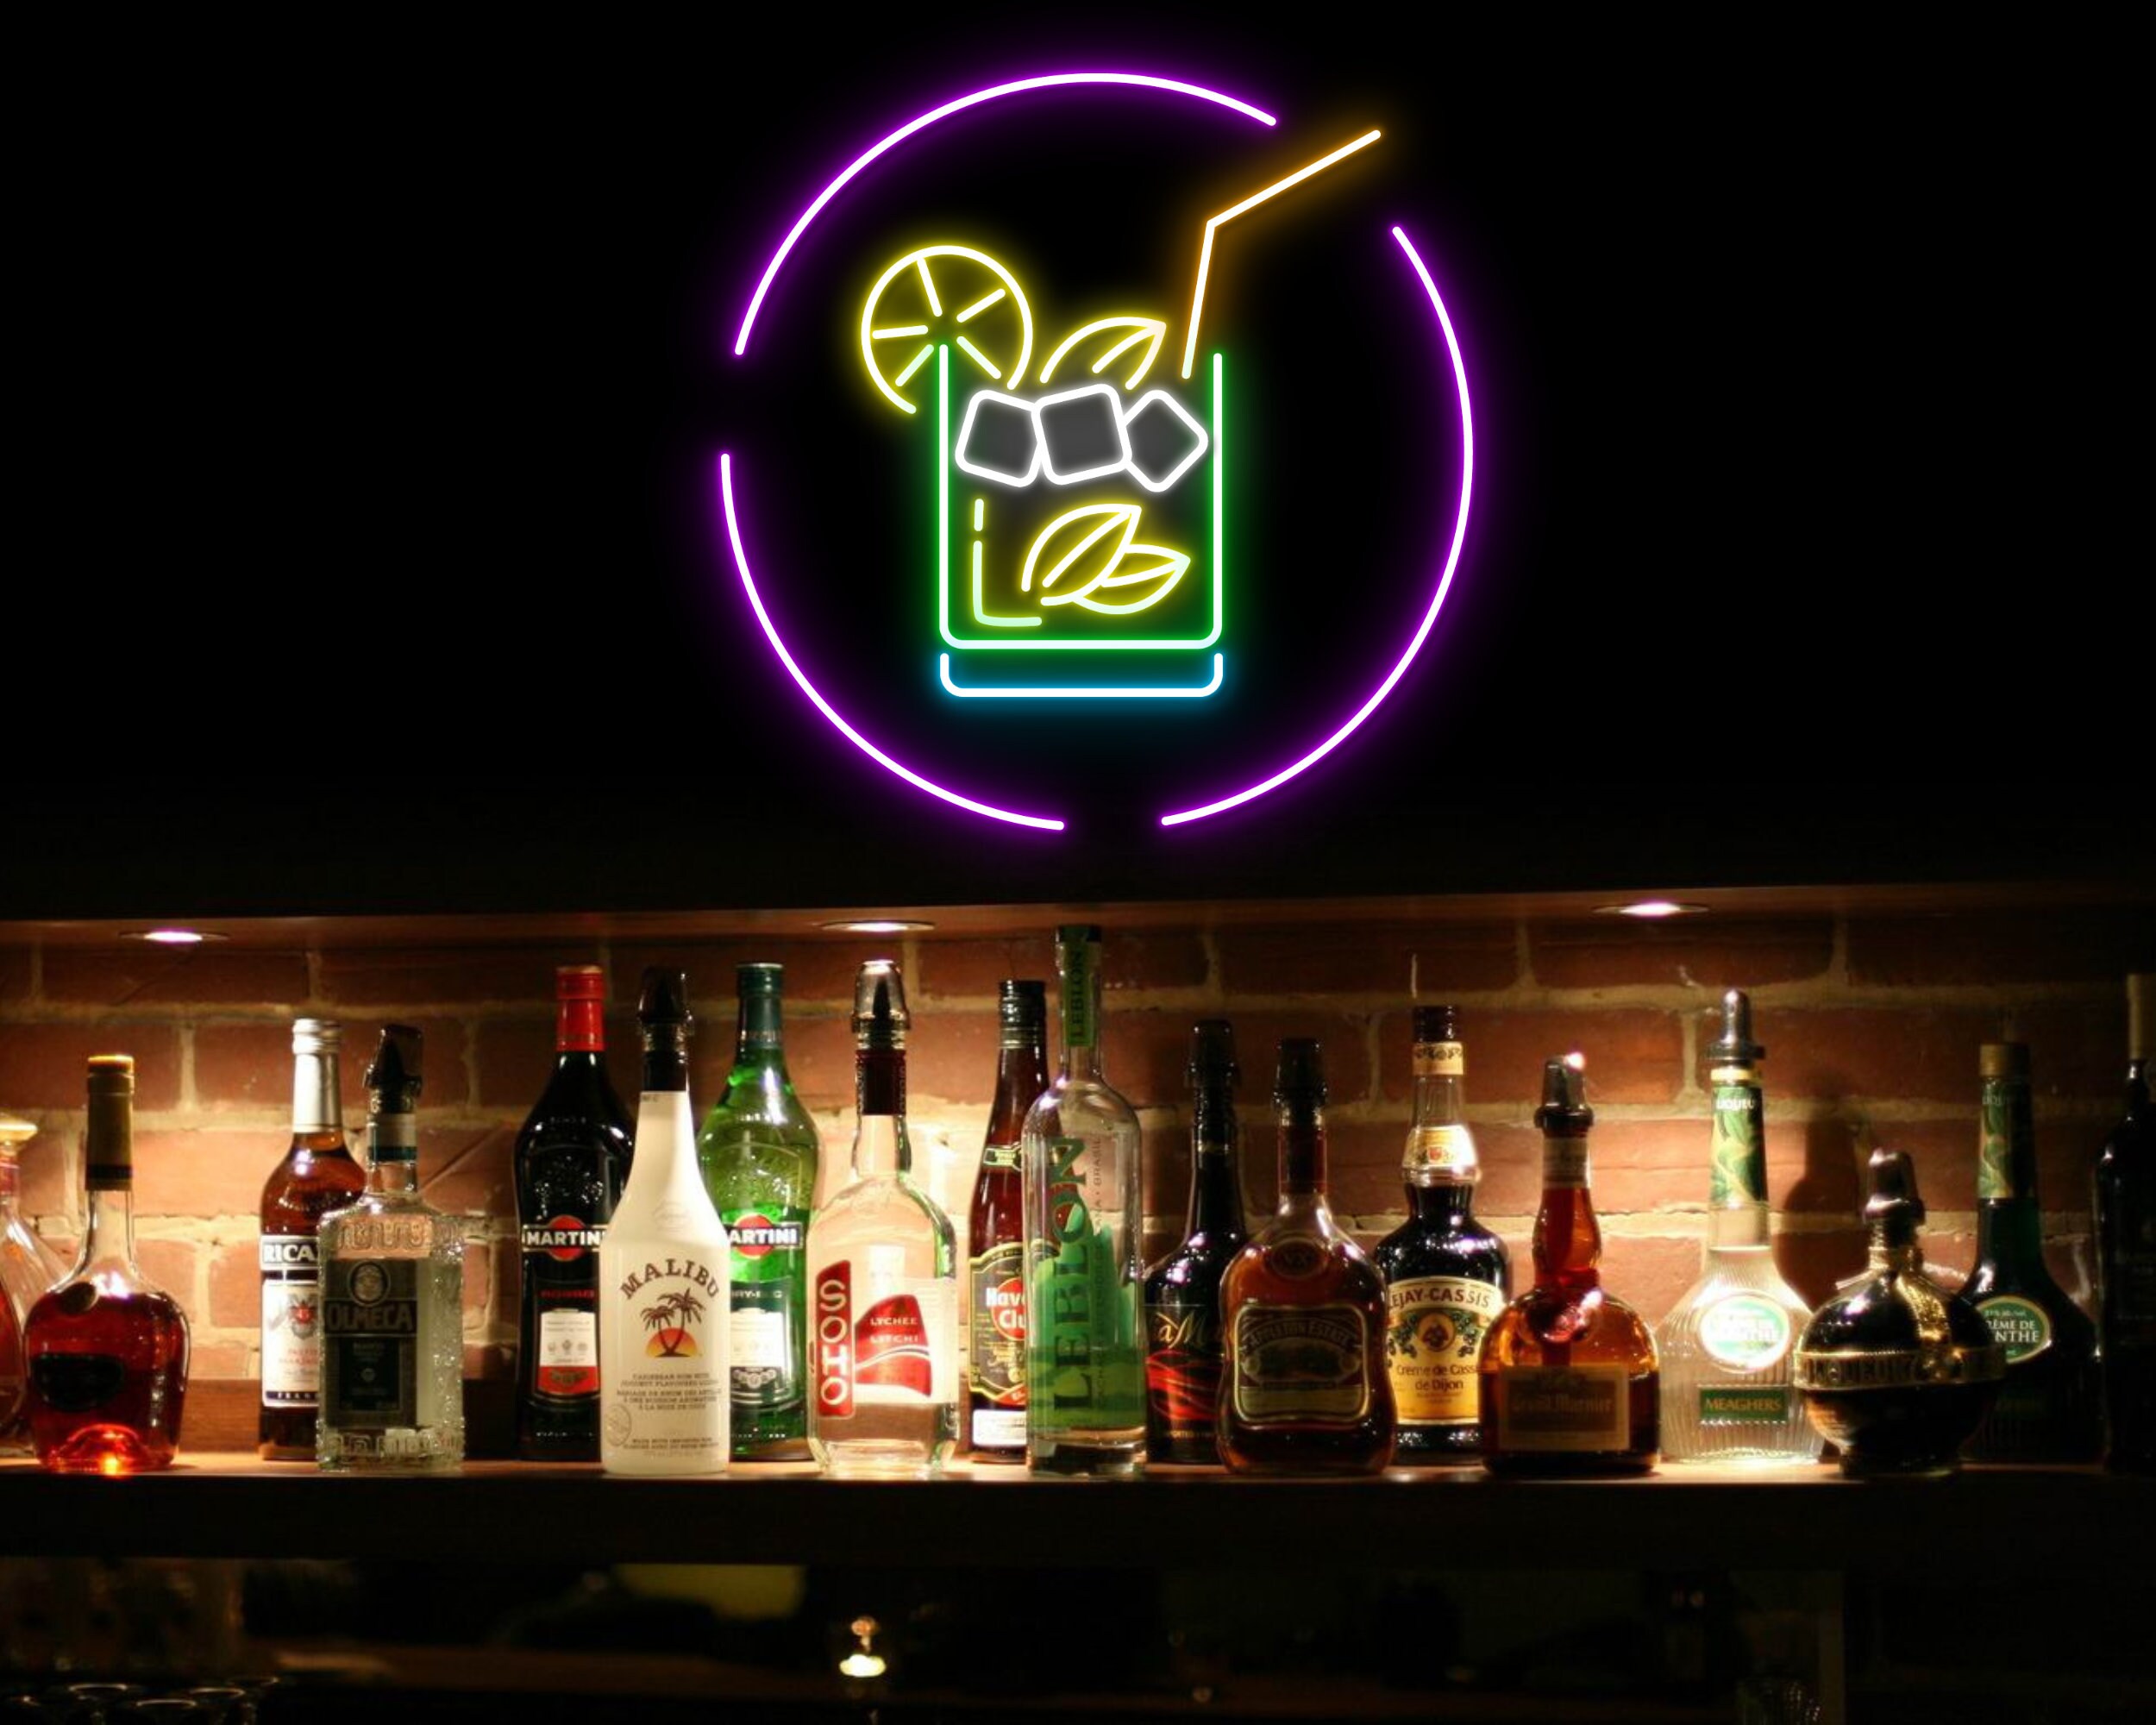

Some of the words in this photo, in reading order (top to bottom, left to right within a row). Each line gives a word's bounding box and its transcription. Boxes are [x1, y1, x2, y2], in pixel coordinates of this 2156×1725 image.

[1091, 1138, 1102, 1187] BRASIL
[526, 1231, 606, 1246] MARTIN
[729, 1228, 798, 1245] ARTINI
[263, 1244, 317, 1263] RICA
[620, 1258, 719, 1300] MALIBU
[1049, 1138, 1091, 1410] LEBLON
[327, 1303, 416, 1332] OLMECA
[870, 1317, 918, 1326] LYCHEE
[2020, 1320, 2036, 1329] DE
[819, 1279, 849, 1406] SOHO
[1994, 1330, 2040, 1343] NTHE
[1415, 1380, 1429, 1390] de
[1432, 1379, 1463, 1392] Dijon
[1705, 1398, 1782, 1412] MEAGHERS
